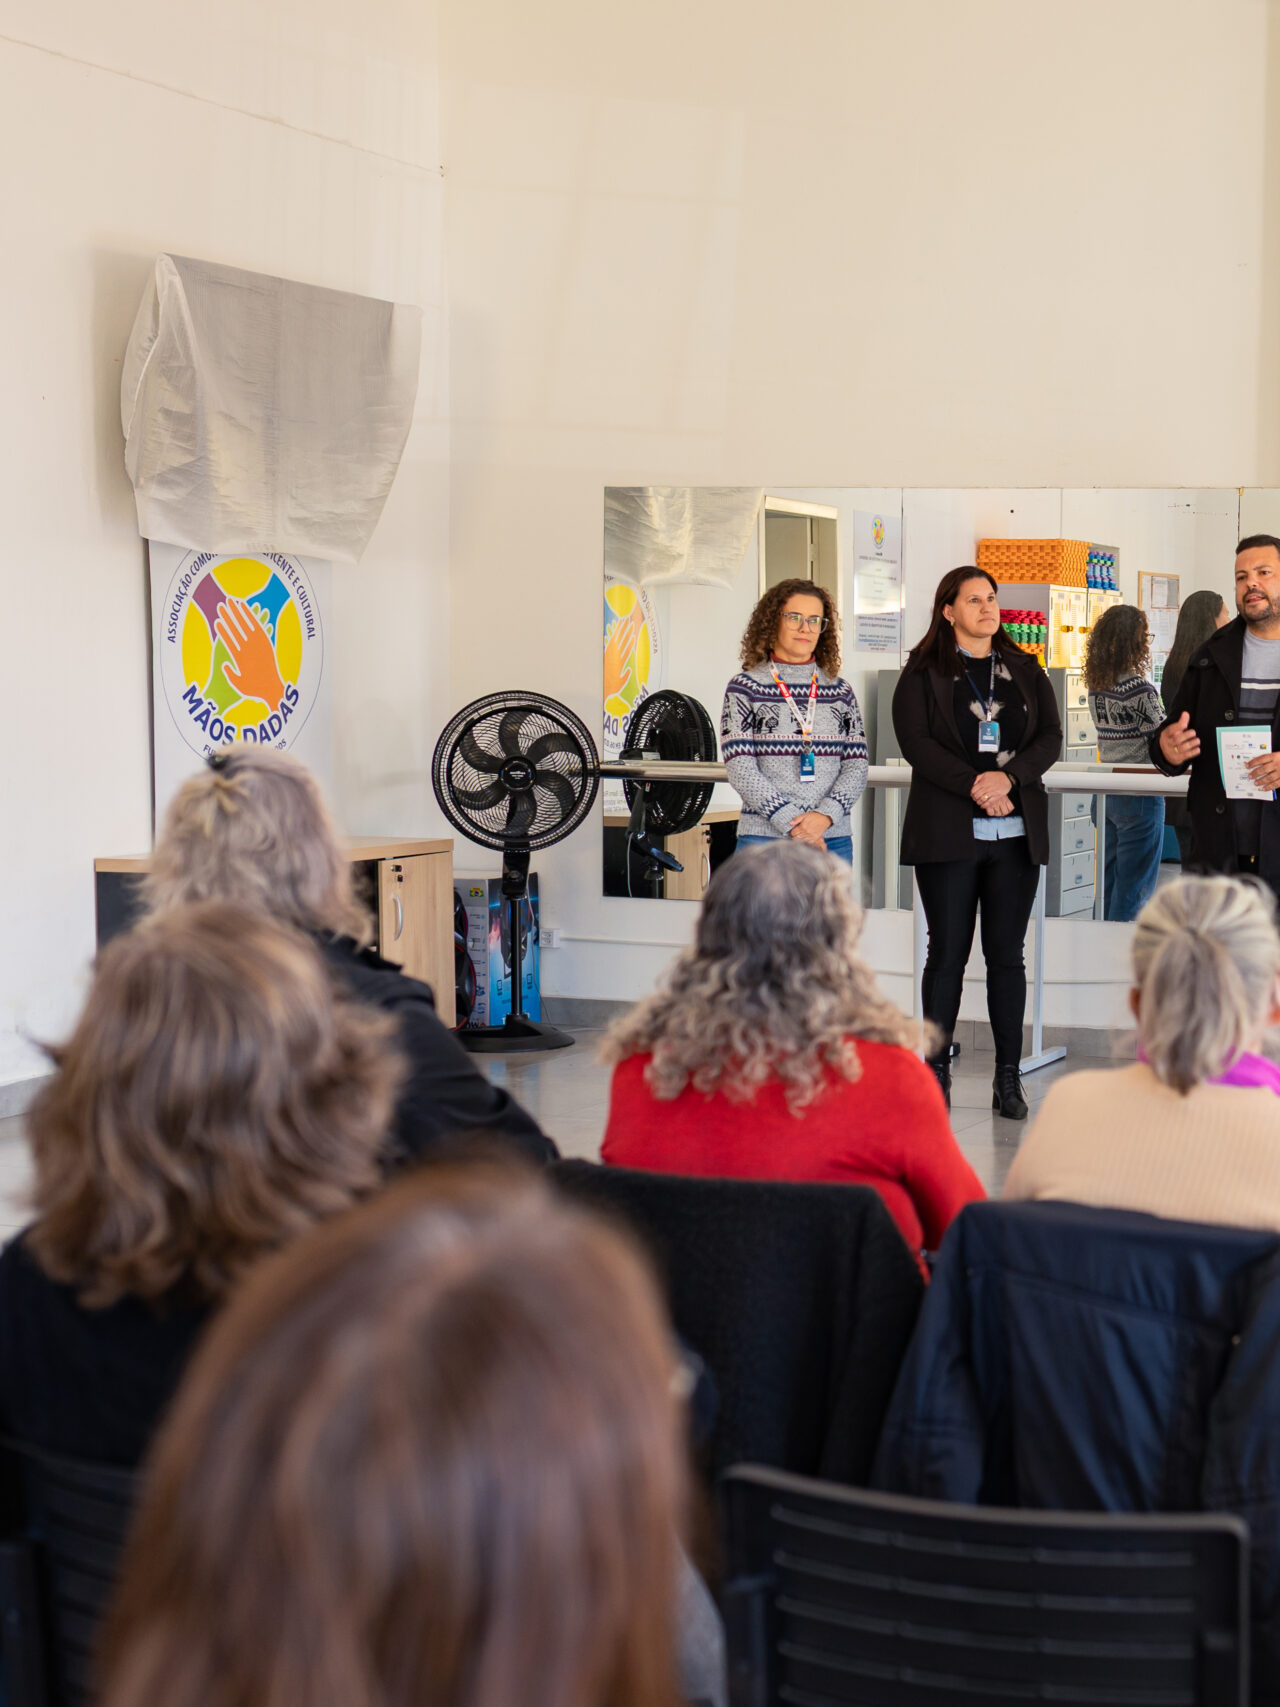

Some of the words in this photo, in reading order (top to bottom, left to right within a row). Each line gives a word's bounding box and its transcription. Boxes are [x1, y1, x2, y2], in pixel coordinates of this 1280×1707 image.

[167, 573, 193, 643] ASSOCIAÇÃO
[292, 576, 300, 588] E
[295, 585, 317, 641] CULTURAL
[182, 684, 236, 746] MÃOS
[242, 684, 300, 745] DADAS
